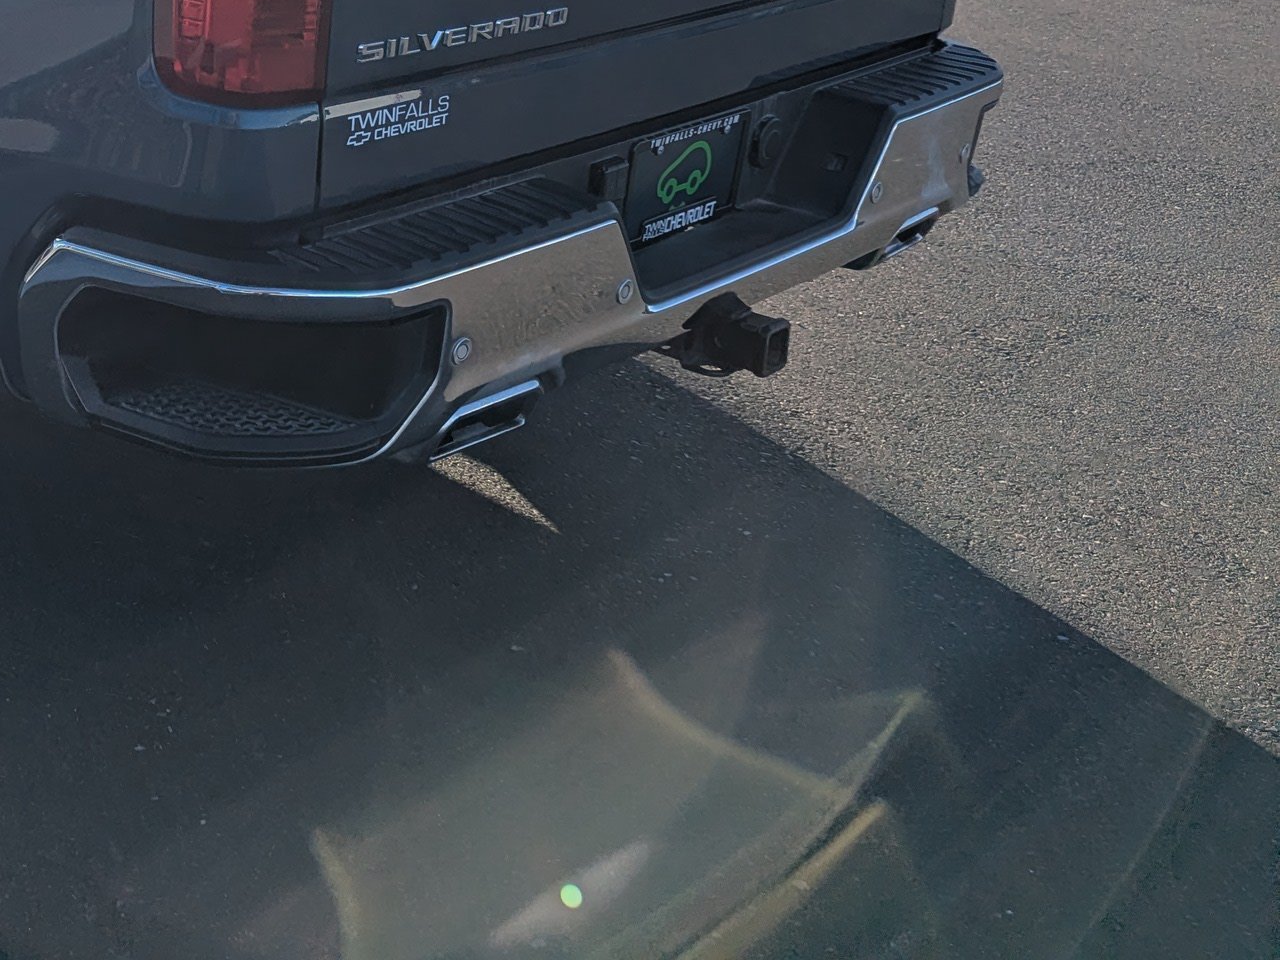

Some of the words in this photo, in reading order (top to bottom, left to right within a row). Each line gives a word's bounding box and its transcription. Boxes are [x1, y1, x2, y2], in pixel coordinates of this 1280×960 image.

[356, 6, 569, 64] SILVERADO
[374, 113, 449, 141] CHEVROLET
[664, 201, 717, 232] CHEVROLET
